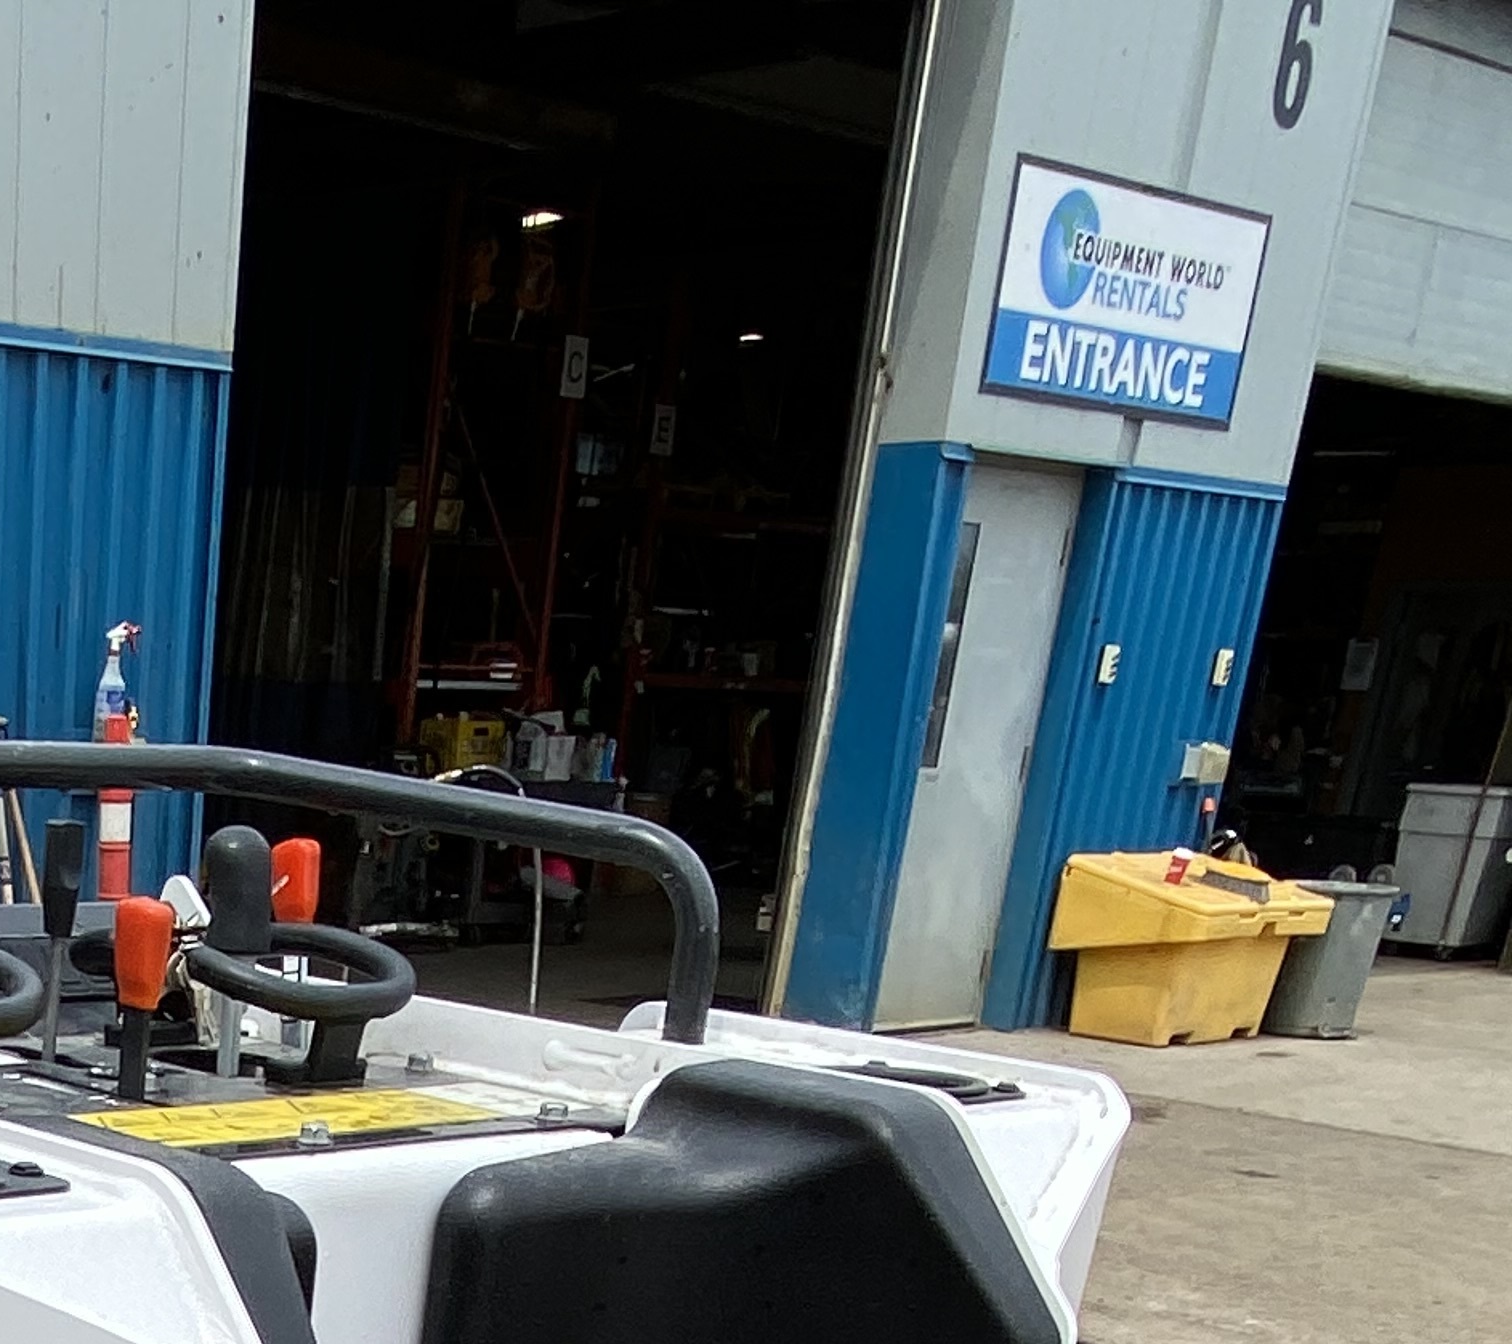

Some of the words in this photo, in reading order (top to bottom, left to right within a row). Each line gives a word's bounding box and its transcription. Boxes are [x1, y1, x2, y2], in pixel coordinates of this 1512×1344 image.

[1273, 0, 1323, 130] 6
[1073, 233, 1165, 279] EQUIPMENT
[1092, 270, 1188, 322] RENTALS
[567, 351, 584, 383] C
[1019, 319, 1211, 408] ENTRANCE
